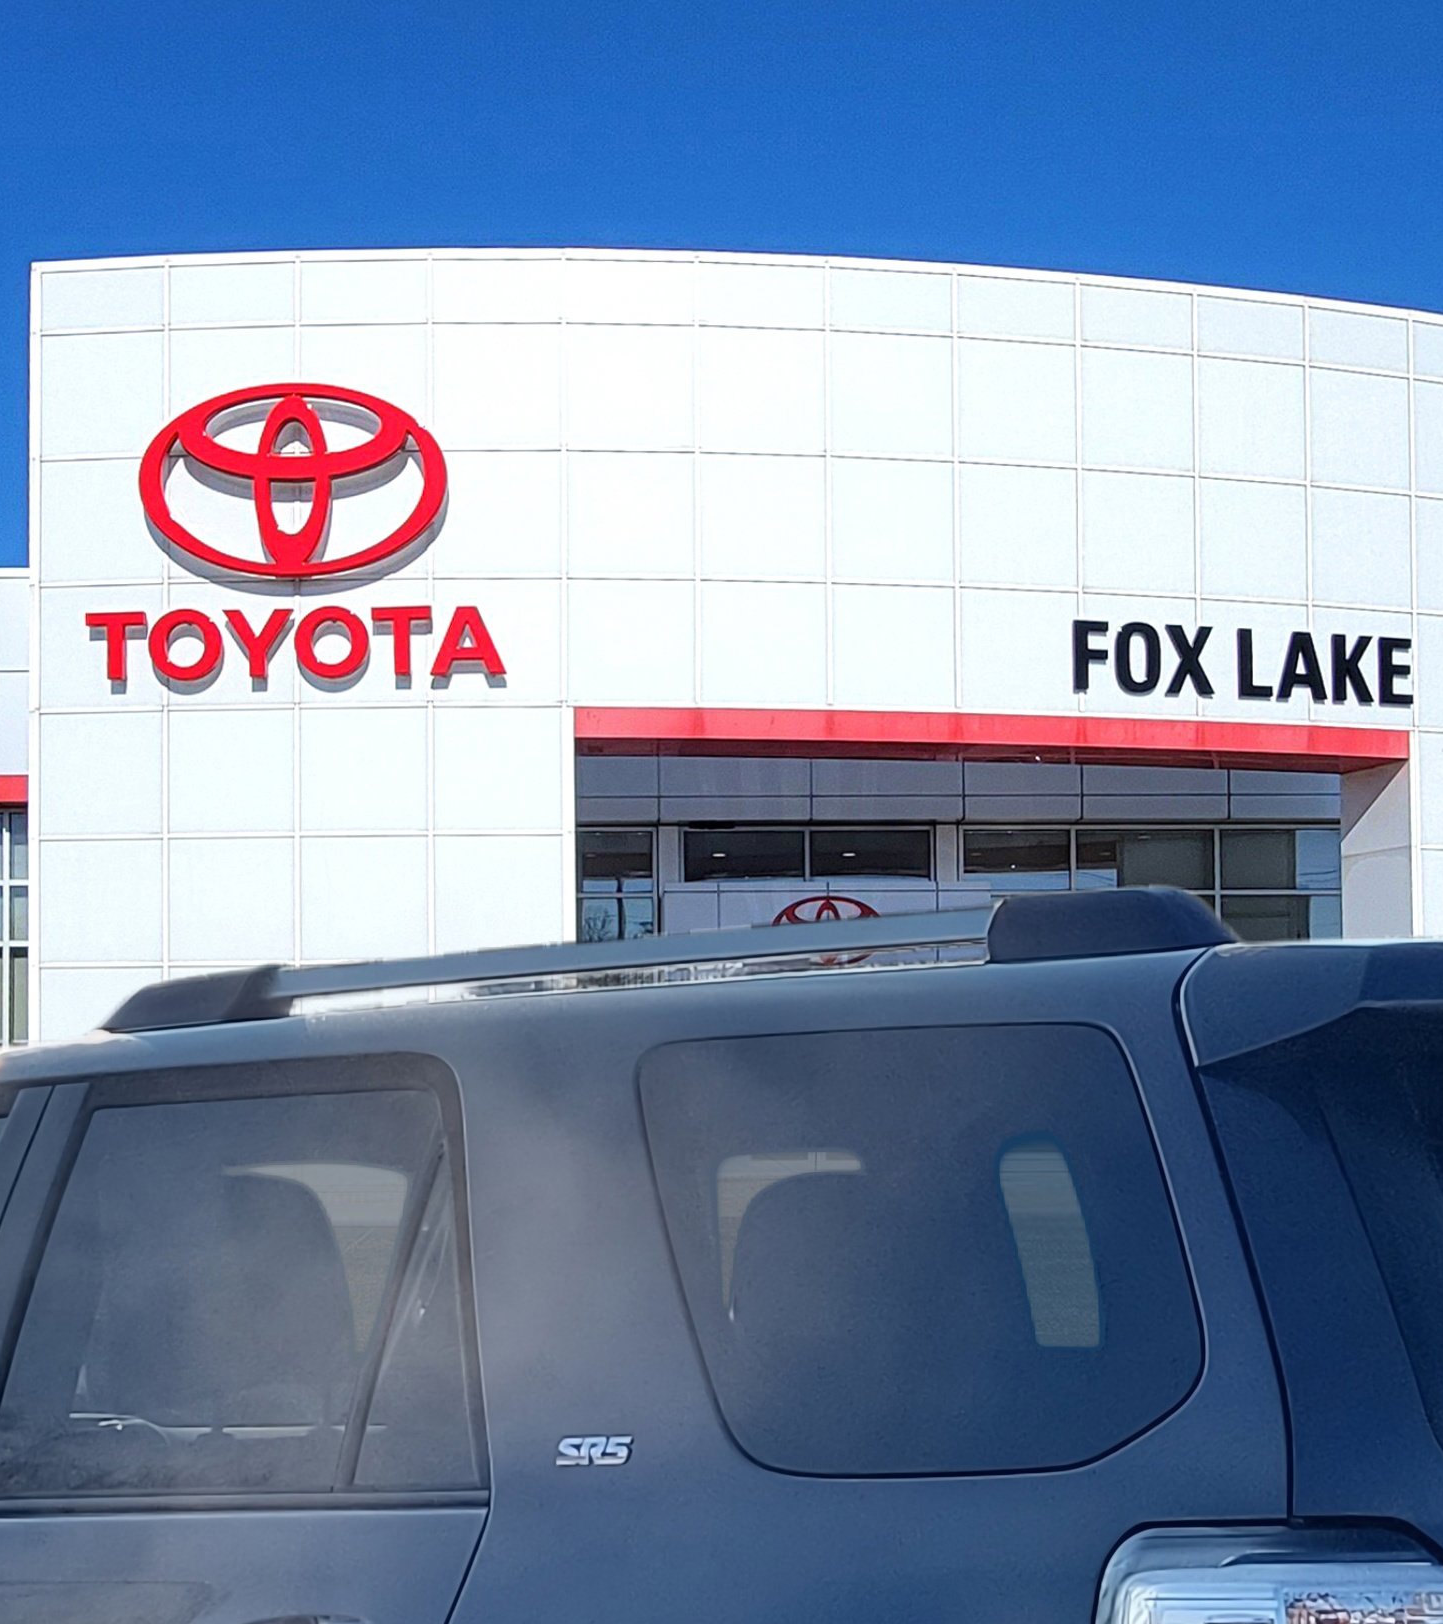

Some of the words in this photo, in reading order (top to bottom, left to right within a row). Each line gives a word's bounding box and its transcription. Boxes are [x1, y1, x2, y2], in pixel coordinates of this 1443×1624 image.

[85, 606, 507, 692] TOYOTA
[1072, 619, 1214, 698] FOX
[1236, 627, 1415, 706] LAKE
[556, 1436, 633, 1466] SR5
